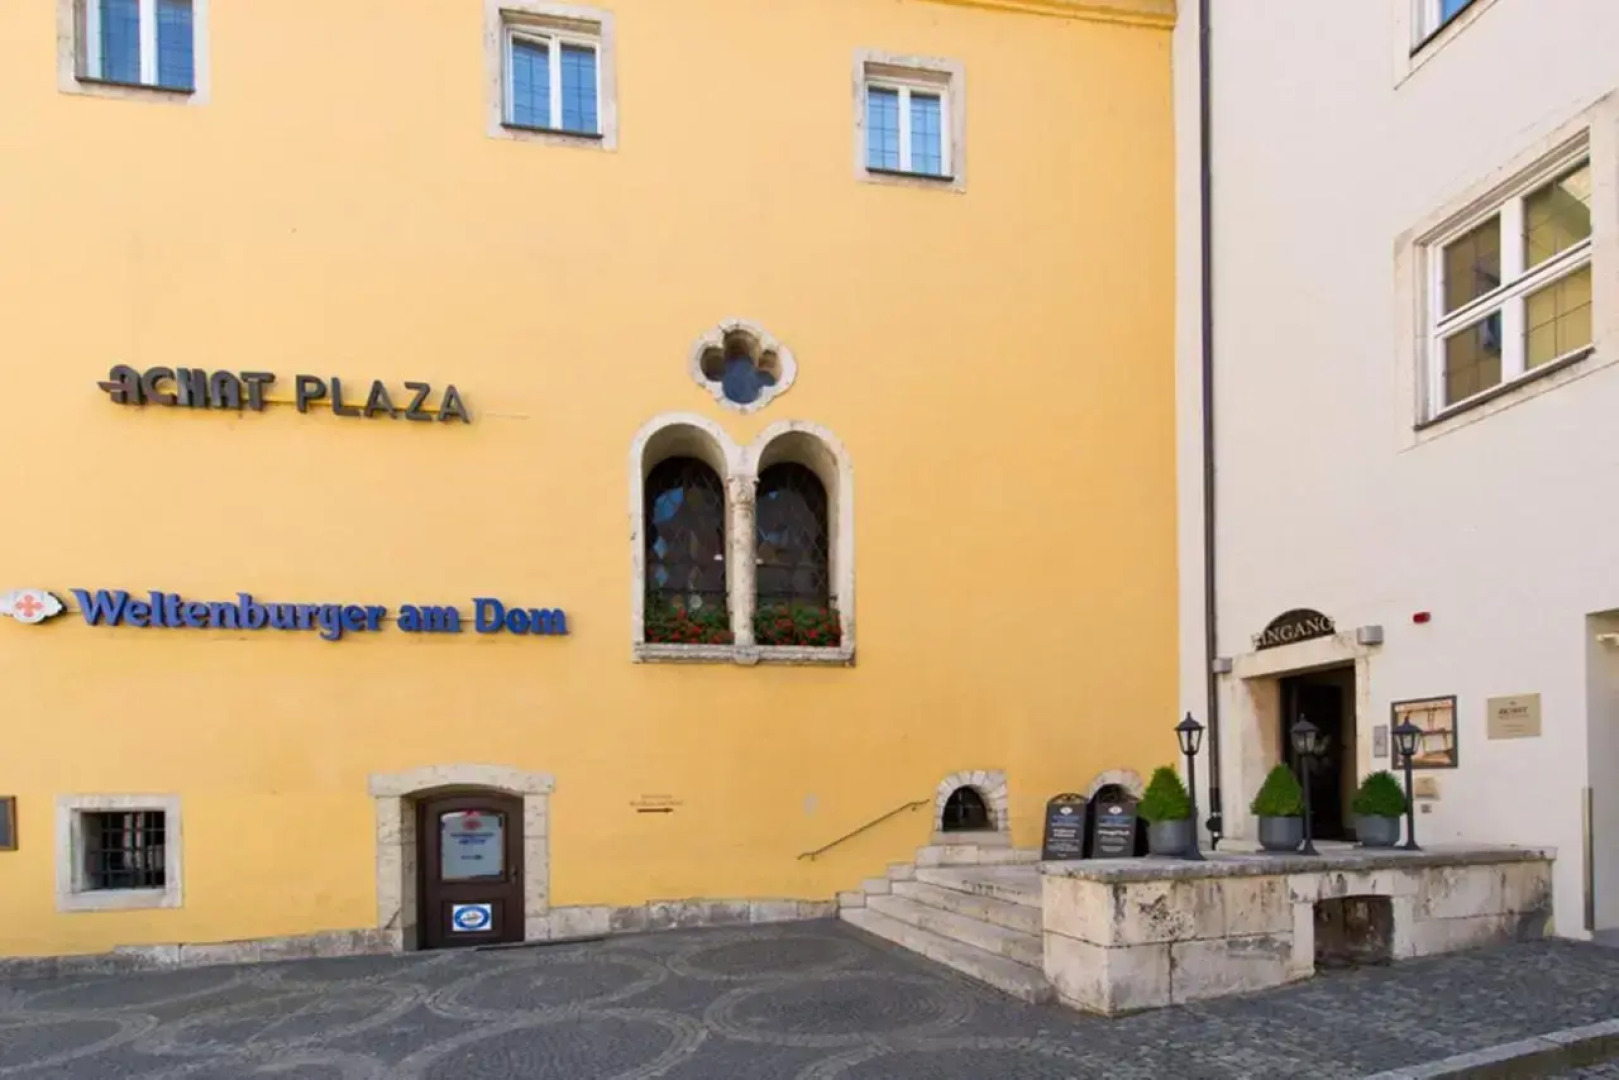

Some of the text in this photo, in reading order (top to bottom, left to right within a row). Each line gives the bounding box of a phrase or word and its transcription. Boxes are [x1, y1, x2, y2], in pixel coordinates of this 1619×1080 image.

[98, 365, 471, 423] ACHAT PLAZA
[73, 589, 567, 639] Weltenburger am Dom
